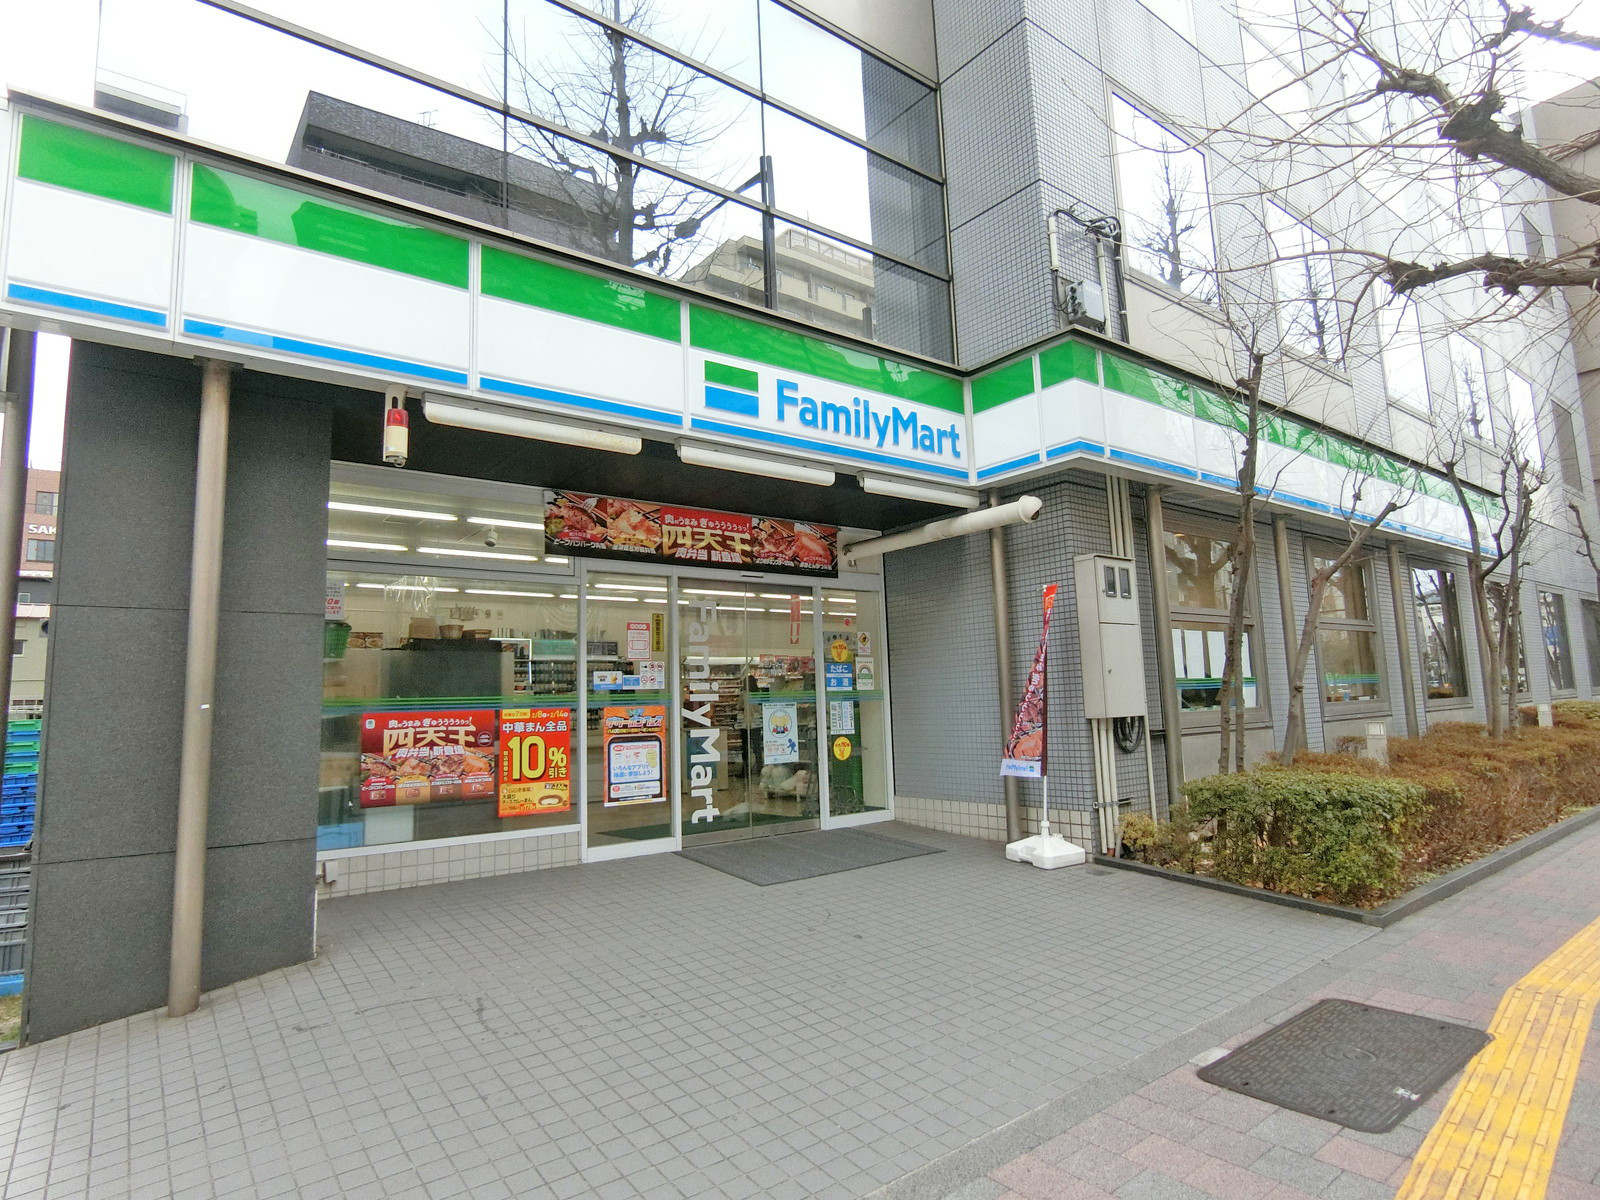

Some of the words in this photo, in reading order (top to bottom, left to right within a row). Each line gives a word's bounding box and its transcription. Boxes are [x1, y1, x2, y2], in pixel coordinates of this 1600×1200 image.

[776, 378, 961, 459] FamilyMart
[662, 524, 752, 558] 四天王
[830, 664, 848, 673] たばこ
[502, 720, 567, 734] 中華まん全品
[681, 599, 721, 824] FamilyMart
[383, 725, 477, 758] 四天王
[548, 767, 568, 779] 引き
